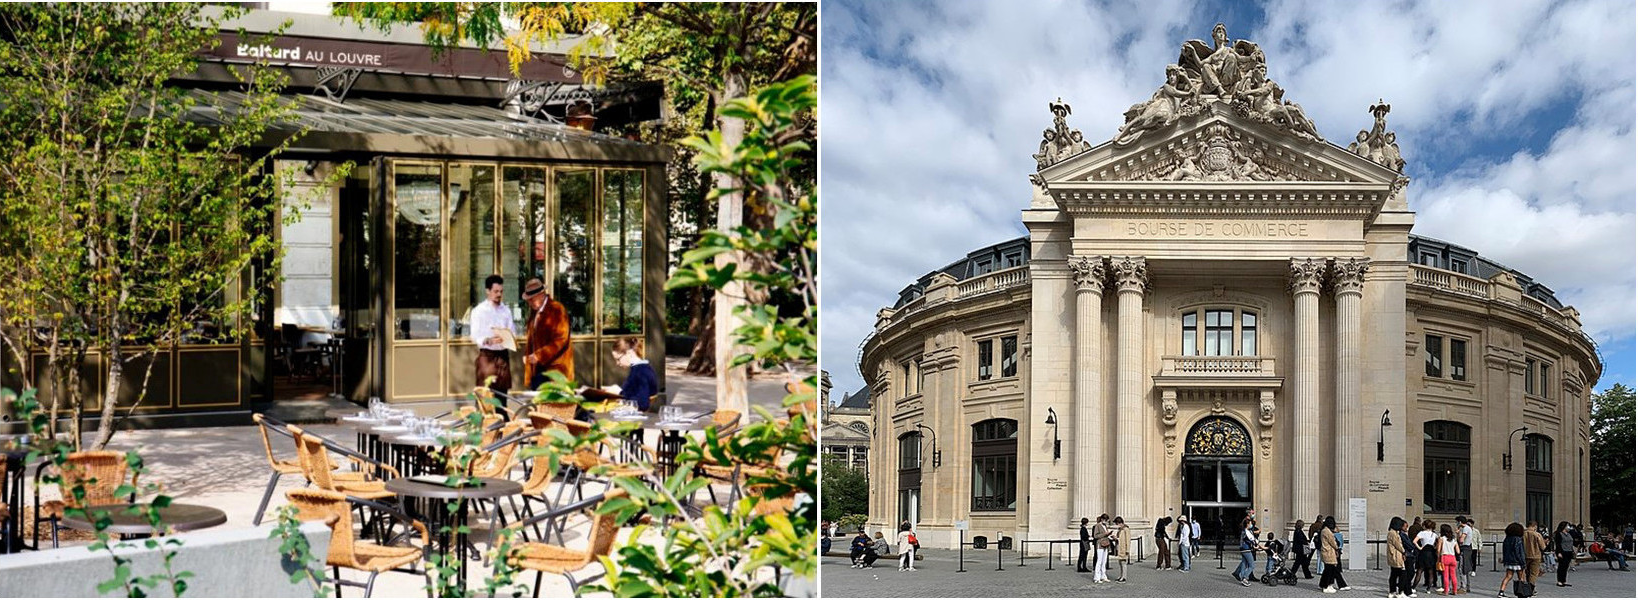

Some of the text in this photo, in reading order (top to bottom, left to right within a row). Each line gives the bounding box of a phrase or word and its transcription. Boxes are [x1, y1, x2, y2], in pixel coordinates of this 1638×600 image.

[305, 50, 324, 62] AU
[329, 51, 383, 66] LOUVRE
[1127, 222, 1309, 237] BOURSE DE COMMERCE
